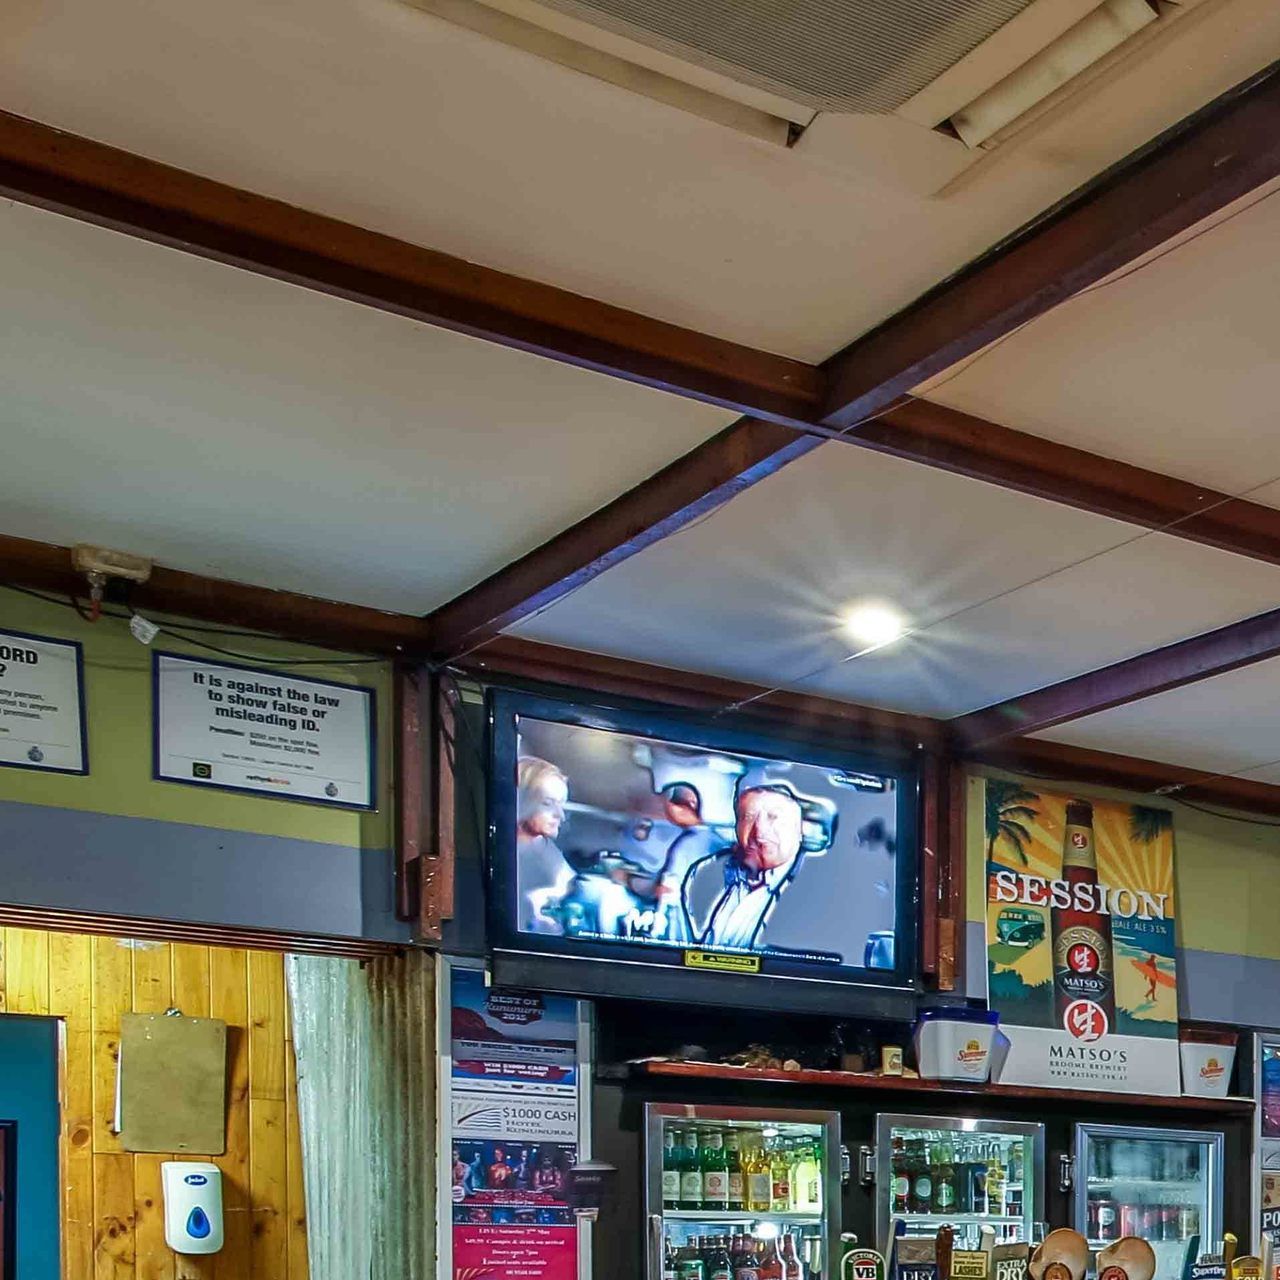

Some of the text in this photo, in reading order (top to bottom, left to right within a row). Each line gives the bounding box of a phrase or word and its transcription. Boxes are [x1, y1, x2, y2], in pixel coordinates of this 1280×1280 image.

[193, 672, 340, 707] It is against the law
[208, 689, 327, 719] to show false or
[215, 706, 320, 732] misleading ID.
[995, 870, 1168, 922] SESSION
[1064, 977, 1105, 989] MATSO'S
[1049, 1045, 1127, 1063] MATSO'S
[502, 1107, 576, 1121] $1000 CASH
[505, 1120, 542, 1128] HOTEL
[506, 1127, 574, 1137] KUNUNURRA
[849, 1252, 881, 1264] VICTORIA
[953, 1265, 983, 1276] LASHES
[996, 1259, 1028, 1270] EXTRA
[854, 1266, 876, 1278] VB
